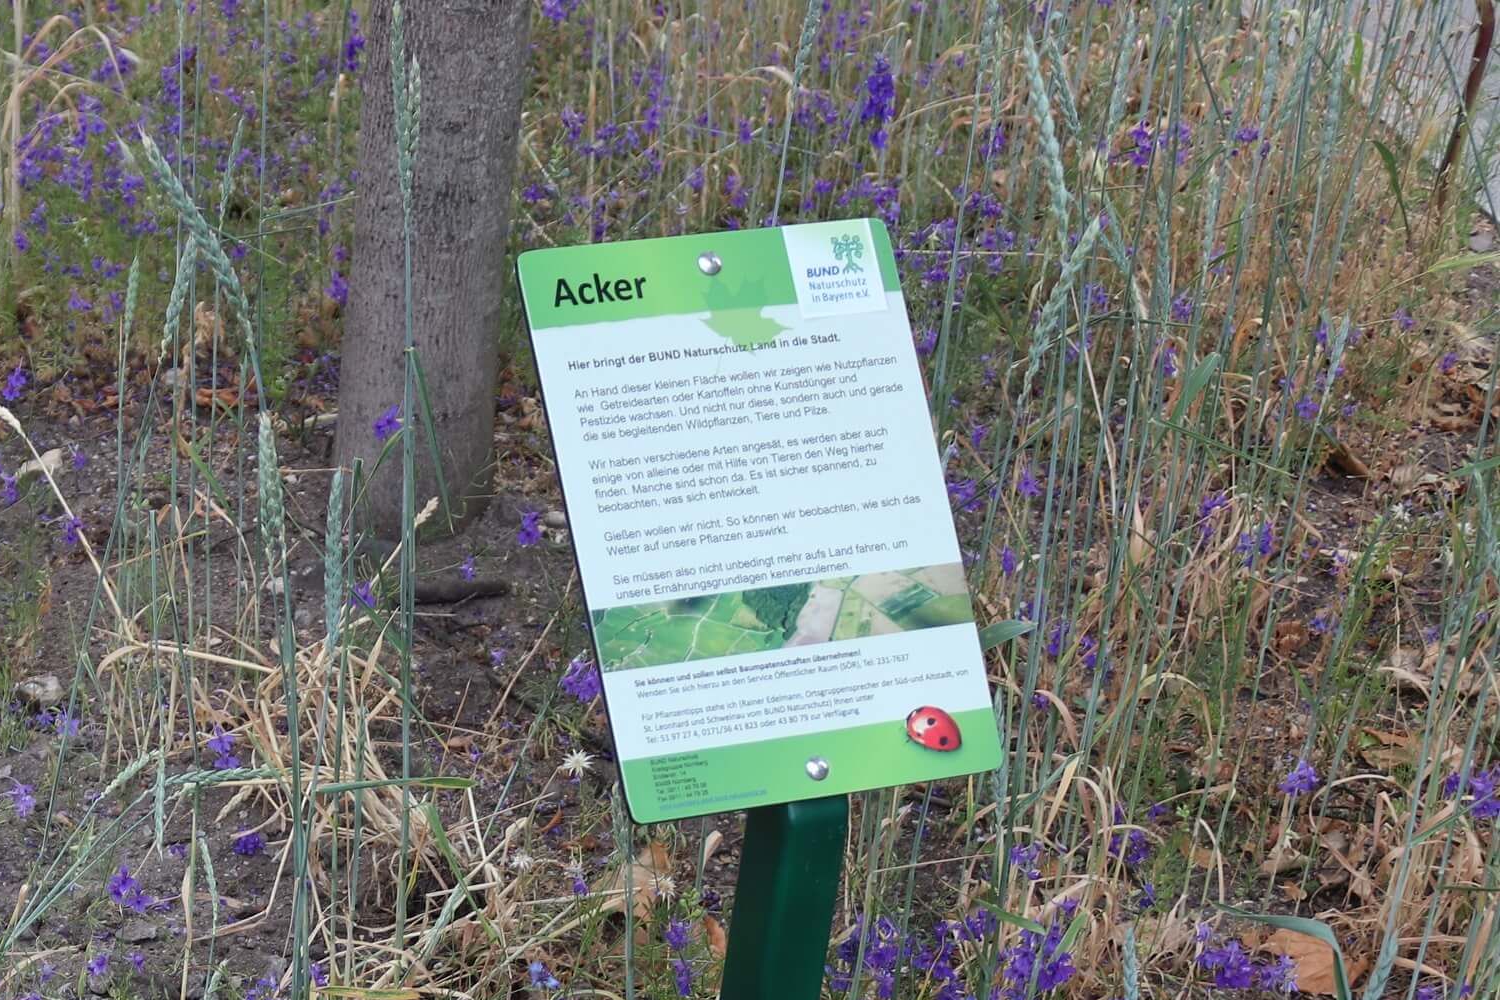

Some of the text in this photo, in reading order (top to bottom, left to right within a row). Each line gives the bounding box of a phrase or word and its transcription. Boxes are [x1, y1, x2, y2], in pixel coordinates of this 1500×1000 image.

[806, 265, 840, 278] BUND
[808, 277, 866, 290] Naturschutz
[555, 273, 646, 307] Acker
[811, 288, 870, 303] in Bayern e.V.
[568, 333, 840, 371] Hier bringt der BUND Naturschutz Land in die Stadt.
[574, 356, 897, 399] An Hand dieser kleinen Fläche wollen wir zeigen wie Nutzpflanzen
[576, 372, 858, 413] wie Getreidearten oder Kartoffeln ohne Kunstdünger und
[580, 414, 627, 427] Pestizide
[678, 405, 701, 416] Und
[702, 402, 728, 414] nicht
[729, 401, 745, 411] nur
[780, 393, 820, 405] sondern
[821, 389, 847, 400] auch
[848, 386, 867, 397] und
[869, 383, 903, 397] gerade
[583, 432, 599, 442] die
[601, 430, 616, 440] sie
[618, 422, 683, 438] begleitenden
[754, 411, 780, 421] Tiere
[782, 407, 802, 419] und
[588, 459, 606, 470] Wir
[609, 457, 641, 468] haben
[643, 449, 710, 464] verschiedene
[712, 445, 739, 456] Arten
[786, 438, 799, 447] es
[801, 433, 838, 445] werden
[839, 431, 861, 441] aber
[864, 426, 888, 438] auch
[592, 442, 884, 485] einige von alleine oder mit Hilfe von Tieren den Weg hierher
[631, 481, 673, 494] Manche
[675, 477, 697, 489] sind
[698, 475, 729, 487] schon
[749, 469, 763, 481] Es
[765, 468, 778, 478] ist
[779, 465, 809, 477] sicher
[865, 458, 877, 467] zu
[662, 495, 684, 505] was
[686, 490, 707, 503] sich
[603, 529, 642, 542] Gießen
[643, 525, 676, 537] wollen
[678, 523, 693, 533] wir
[725, 516, 741, 527] So
[742, 512, 780, 525] können
[781, 510, 796, 520] wir
[861, 500, 879, 510] wie
[881, 496, 901, 507] sich
[902, 495, 921, 505] das
[606, 545, 640, 556] Wetter
[643, 540, 660, 552] auf
[662, 537, 697, 550] unsere
[699, 532, 743, 544] Pflanzen
[613, 575, 630, 585] Sie
[632, 570, 673, 582] müssen
[675, 567, 697, 577] also
[698, 562, 724, 576] nicht
[725, 555, 775, 571] unbedingt
[777, 552, 802, 564] mehr
[805, 549, 826, 561] aufs
[828, 545, 854, 558] Land
[892, 540, 908, 549] um
[616, 588, 651, 600] unsere
[653, 572, 768, 595] Ernährungsgrundlagen
[647, 676, 675, 685] können
[676, 673, 691, 682] und
[692, 670, 715, 679] sollen
[716, 667, 738, 676] selbst
